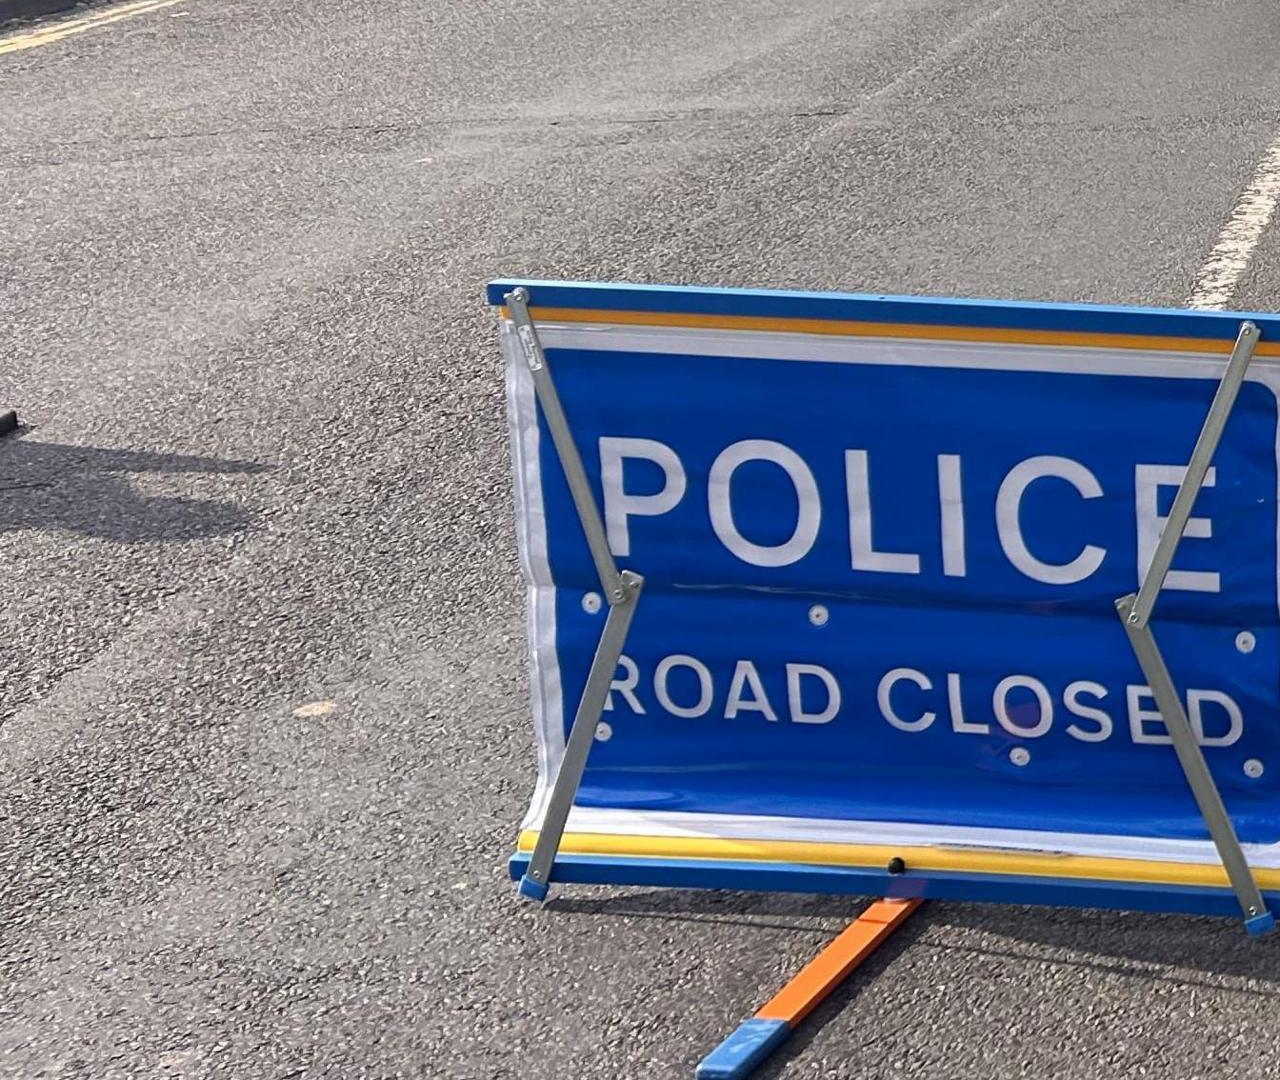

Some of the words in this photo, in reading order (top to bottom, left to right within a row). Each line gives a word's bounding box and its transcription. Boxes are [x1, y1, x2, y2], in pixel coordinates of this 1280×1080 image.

[600, 435, 1221, 593] POLICE
[603, 653, 842, 725] ROAD
[876, 667, 1244, 748] CLOSED
